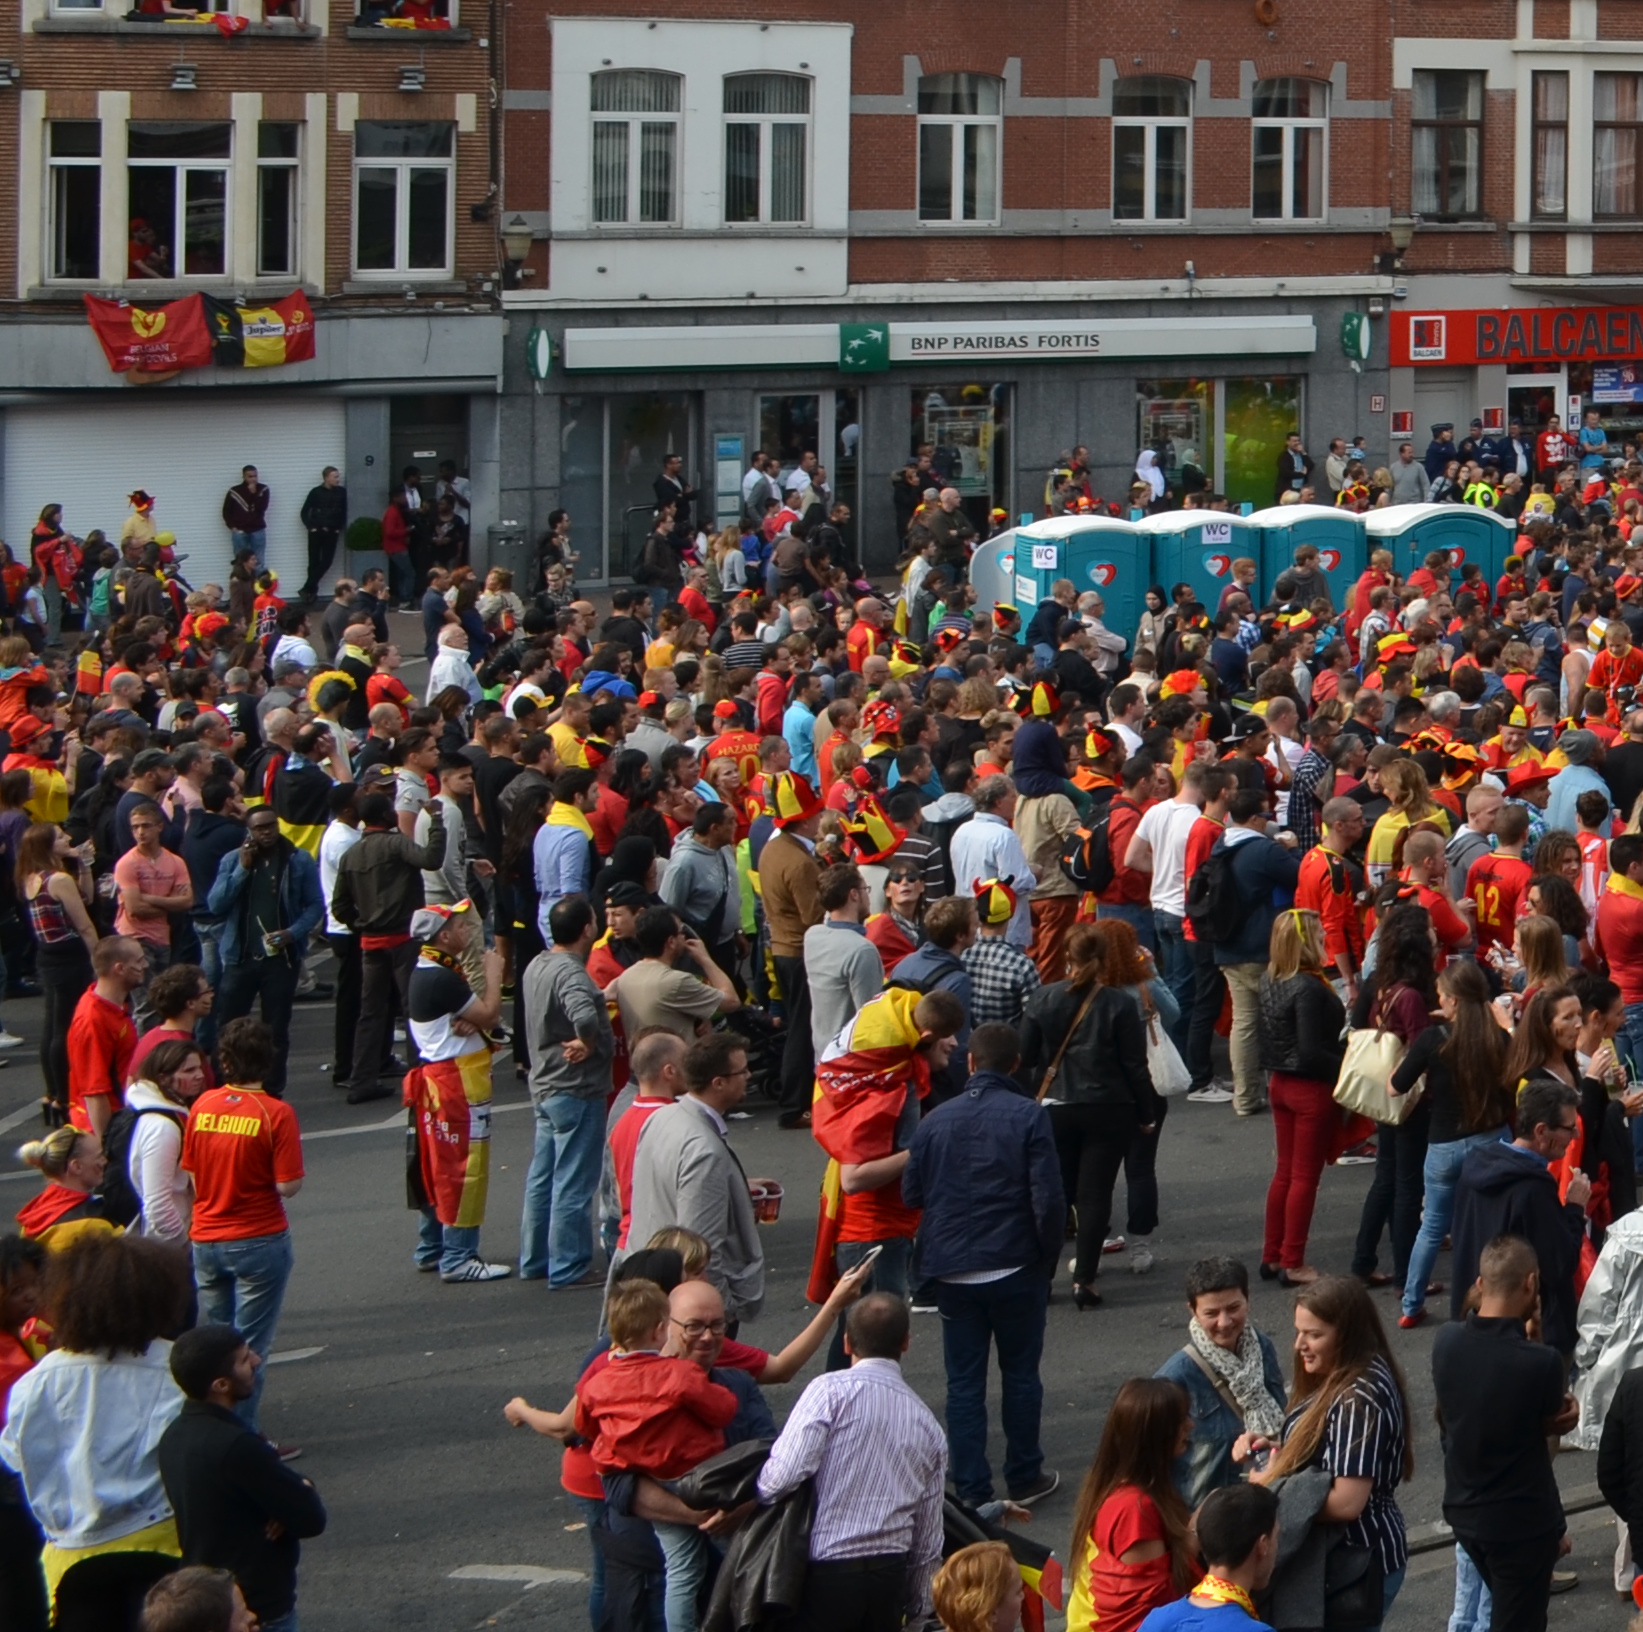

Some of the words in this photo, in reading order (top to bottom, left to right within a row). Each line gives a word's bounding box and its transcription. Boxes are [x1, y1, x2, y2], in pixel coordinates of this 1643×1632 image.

[911, 337, 949, 350] BNP
[953, 335, 1029, 349] PARIBAS
[1038, 334, 1100, 348] FORTIS
[1412, 348, 1443, 357] BALCAEN
[1373, 399, 1382, 409] H
[364, 455, 375, 467] 9
[1204, 523, 1229, 536] WC
[1034, 547, 1055, 561] WC
[1474, 882, 1501, 927] 12
[195, 1112, 261, 1138] BELGIUM
